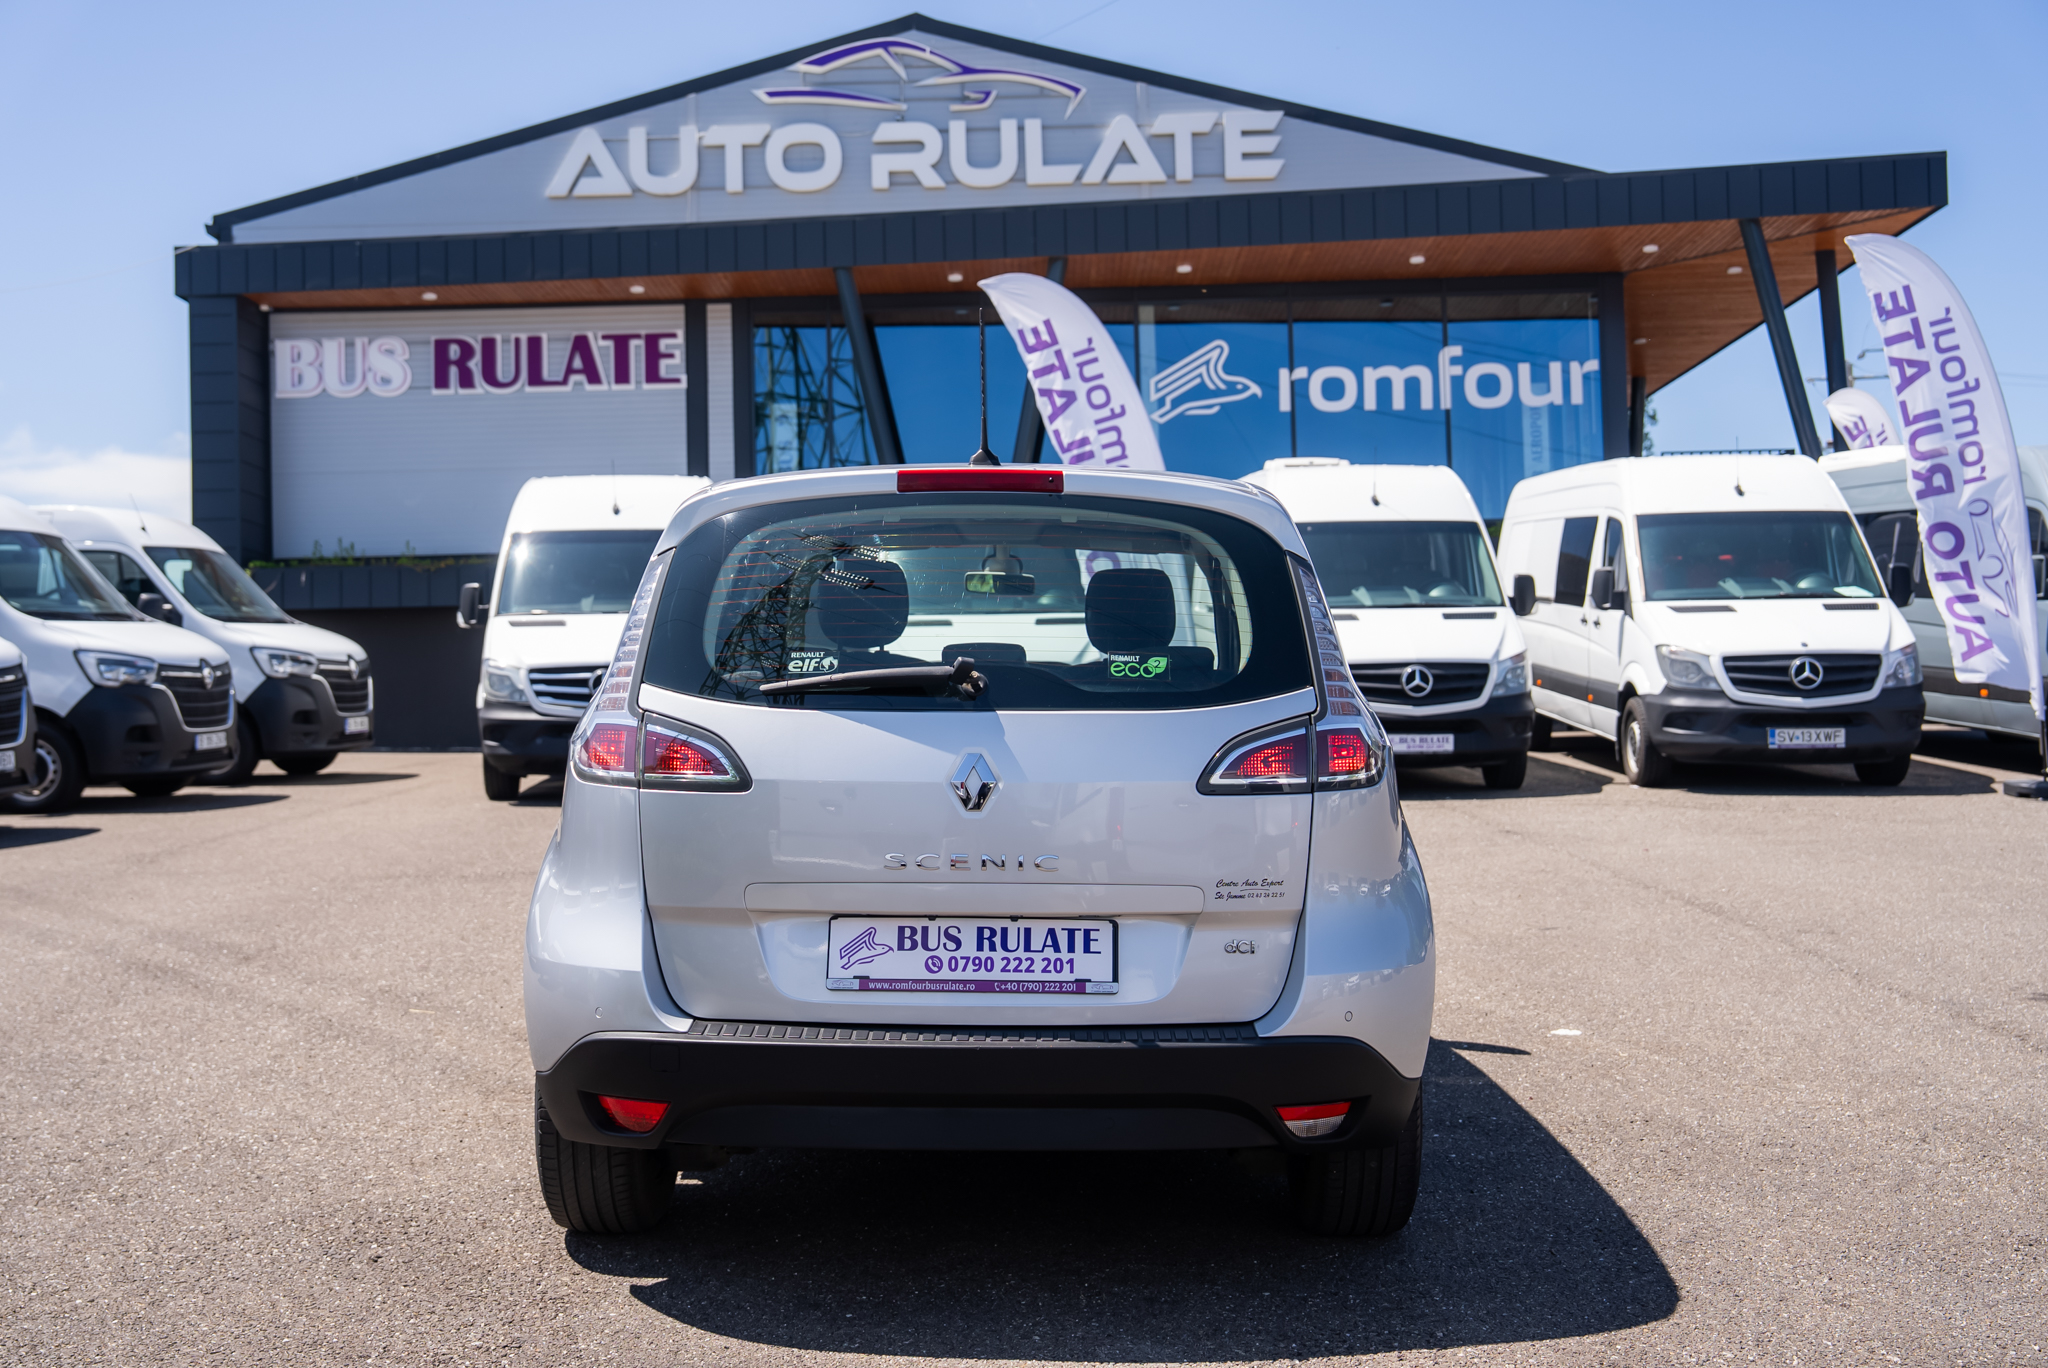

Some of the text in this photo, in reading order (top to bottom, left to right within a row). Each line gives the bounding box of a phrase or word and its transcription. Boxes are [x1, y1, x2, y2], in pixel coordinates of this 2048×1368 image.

[545, 110, 1286, 198] AUTO RULATE
[274, 329, 686, 397] BUS RULATE
[1279, 345, 1599, 413] romfour
[788, 658, 820, 672] elf
[1110, 654, 1140, 662] RENAULT
[884, 853, 1060, 872] SCENIC
[1215, 878, 1284, 888] Centre Auto Expert
[897, 925, 1102, 954] BUS RULATE
[947, 955, 1075, 974] 0790 222 201
[868, 980, 975, 991] www.romfourbusrulate.ro
[1000, 982, 1076, 992] +40 (790) 222 201
